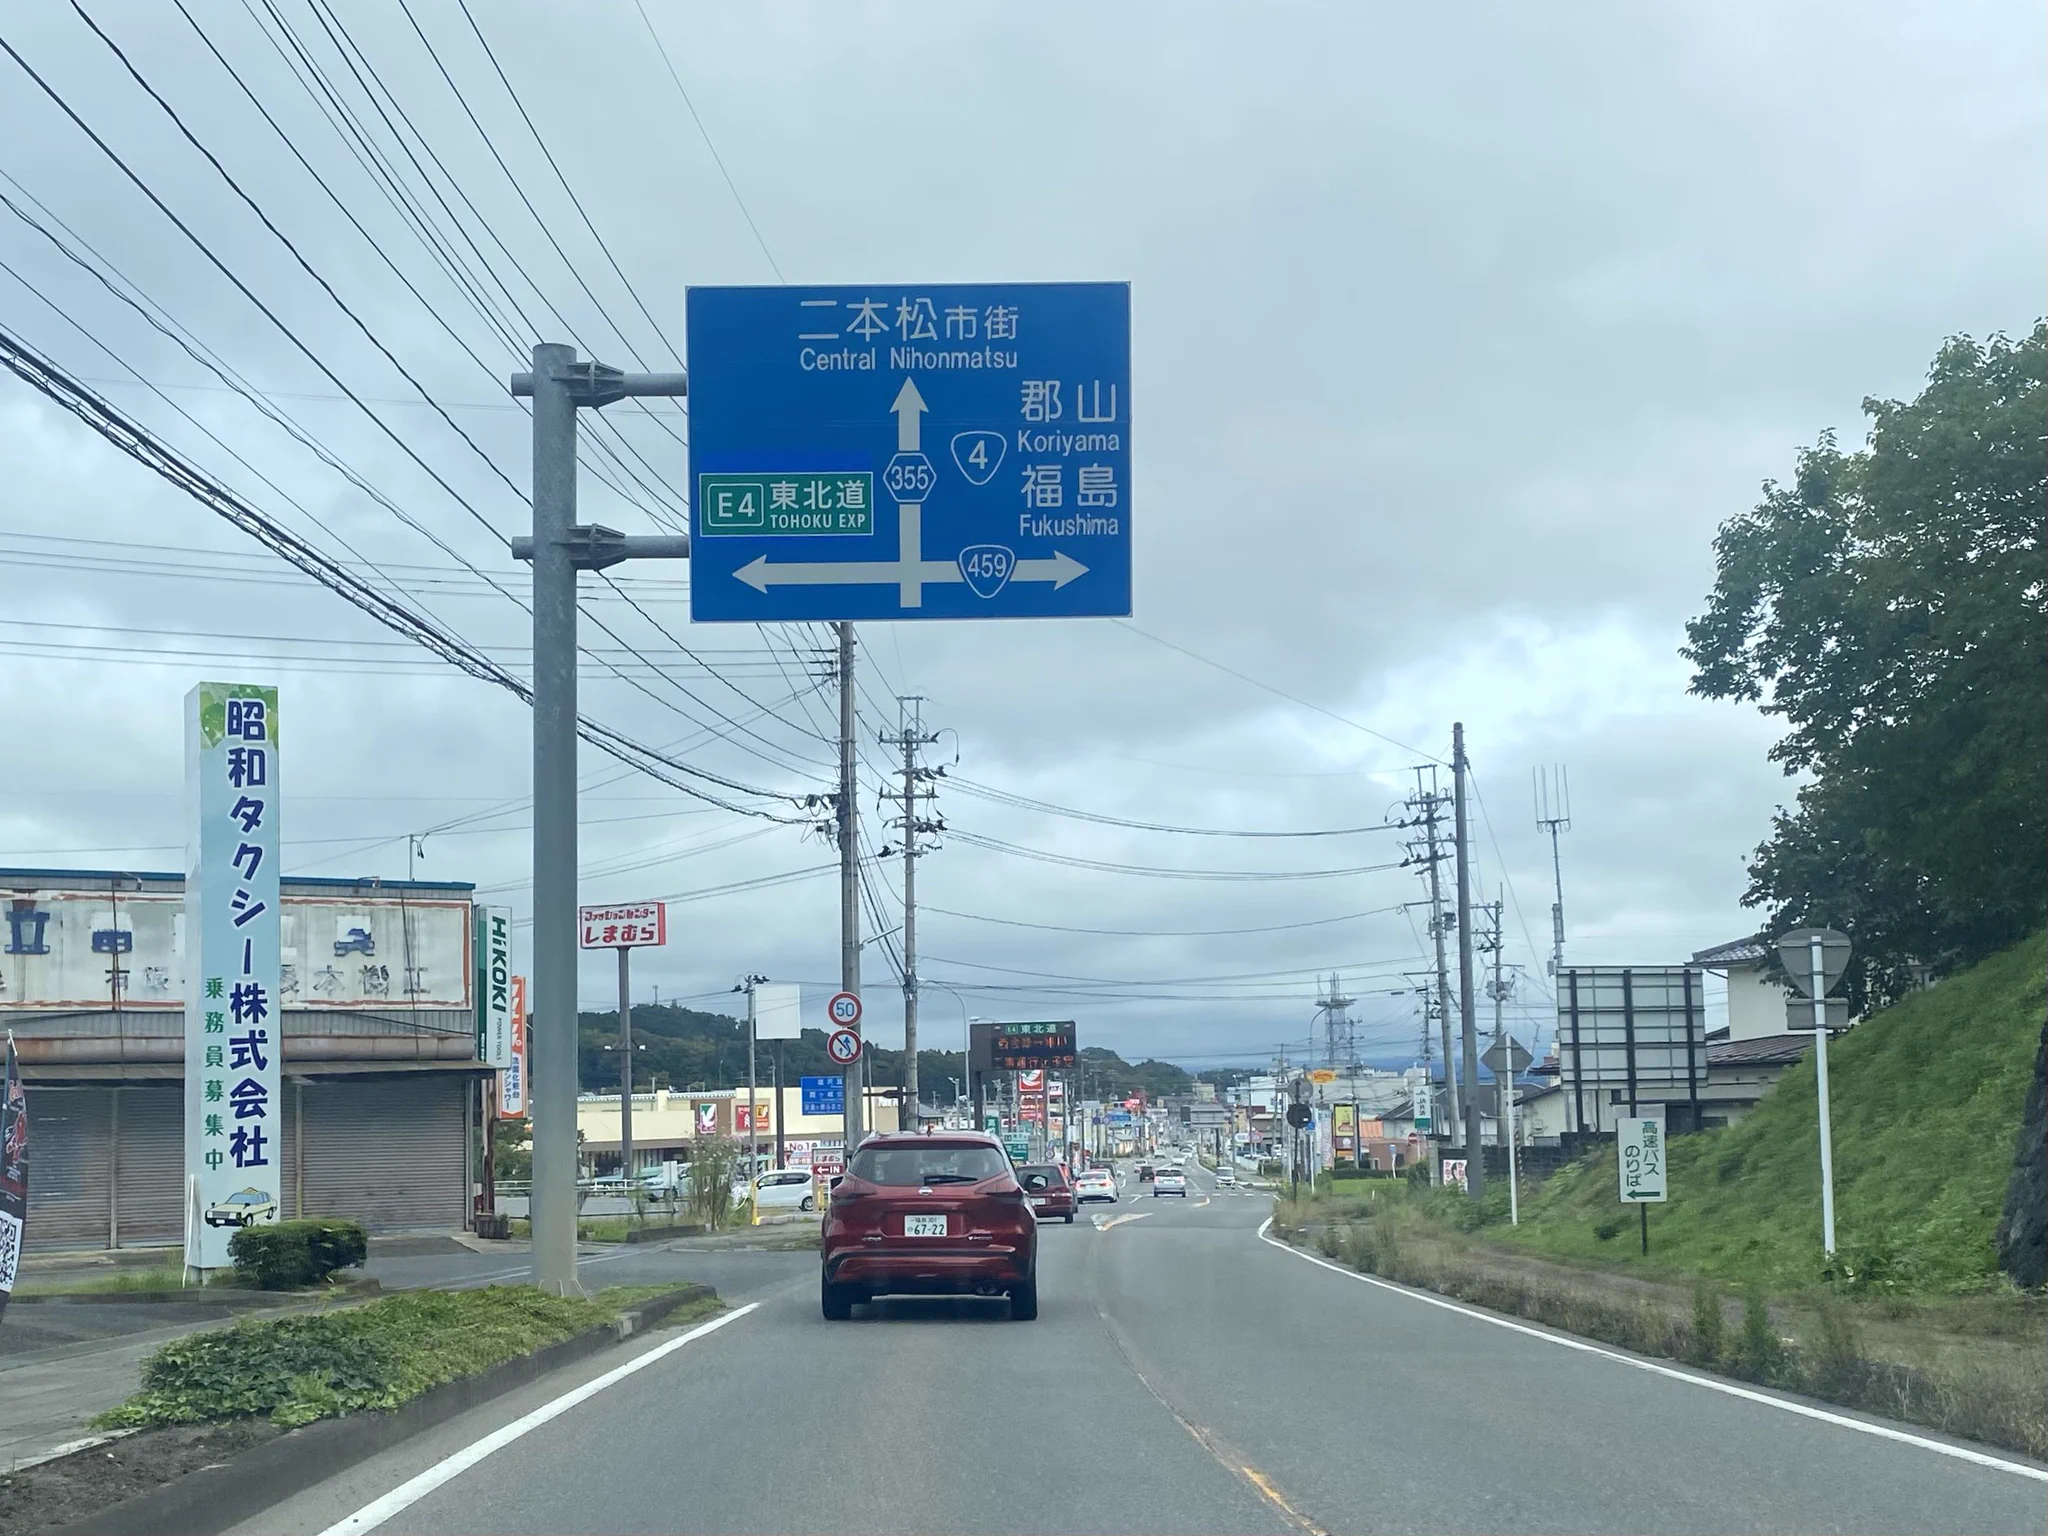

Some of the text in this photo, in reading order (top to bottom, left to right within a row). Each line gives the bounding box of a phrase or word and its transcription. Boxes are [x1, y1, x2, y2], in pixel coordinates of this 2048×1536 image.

[799, 297, 1018, 342] 二本松市街
[800, 346, 1018, 370] Central Nihonmatsu
[1020, 379, 1117, 423] 郡山
[968, 440, 988, 469] 4
[1018, 430, 1120, 456] Koriyama
[890, 465, 928, 490] 355
[1021, 463, 1118, 508] 福島
[718, 493, 756, 518] E4
[769, 480, 866, 510] 東北道
[770, 513, 866, 529] TOHOKU EXP
[1020, 513, 1118, 537] Fukushima
[967, 554, 1007, 577] 459
[227, 700, 268, 1168] 昭和タクシー株式会社
[585, 923, 656, 944] しまむら
[836, 1002, 855, 1017] 50
[1020, 1024, 1056, 1034] 東北道
[205, 977, 224, 1170] 乗務員募集中
[1642, 1121, 1659, 1176] 高速バス
[1625, 1145, 1642, 1187] のりば
[914, 1224, 944, 1235] 67-22
